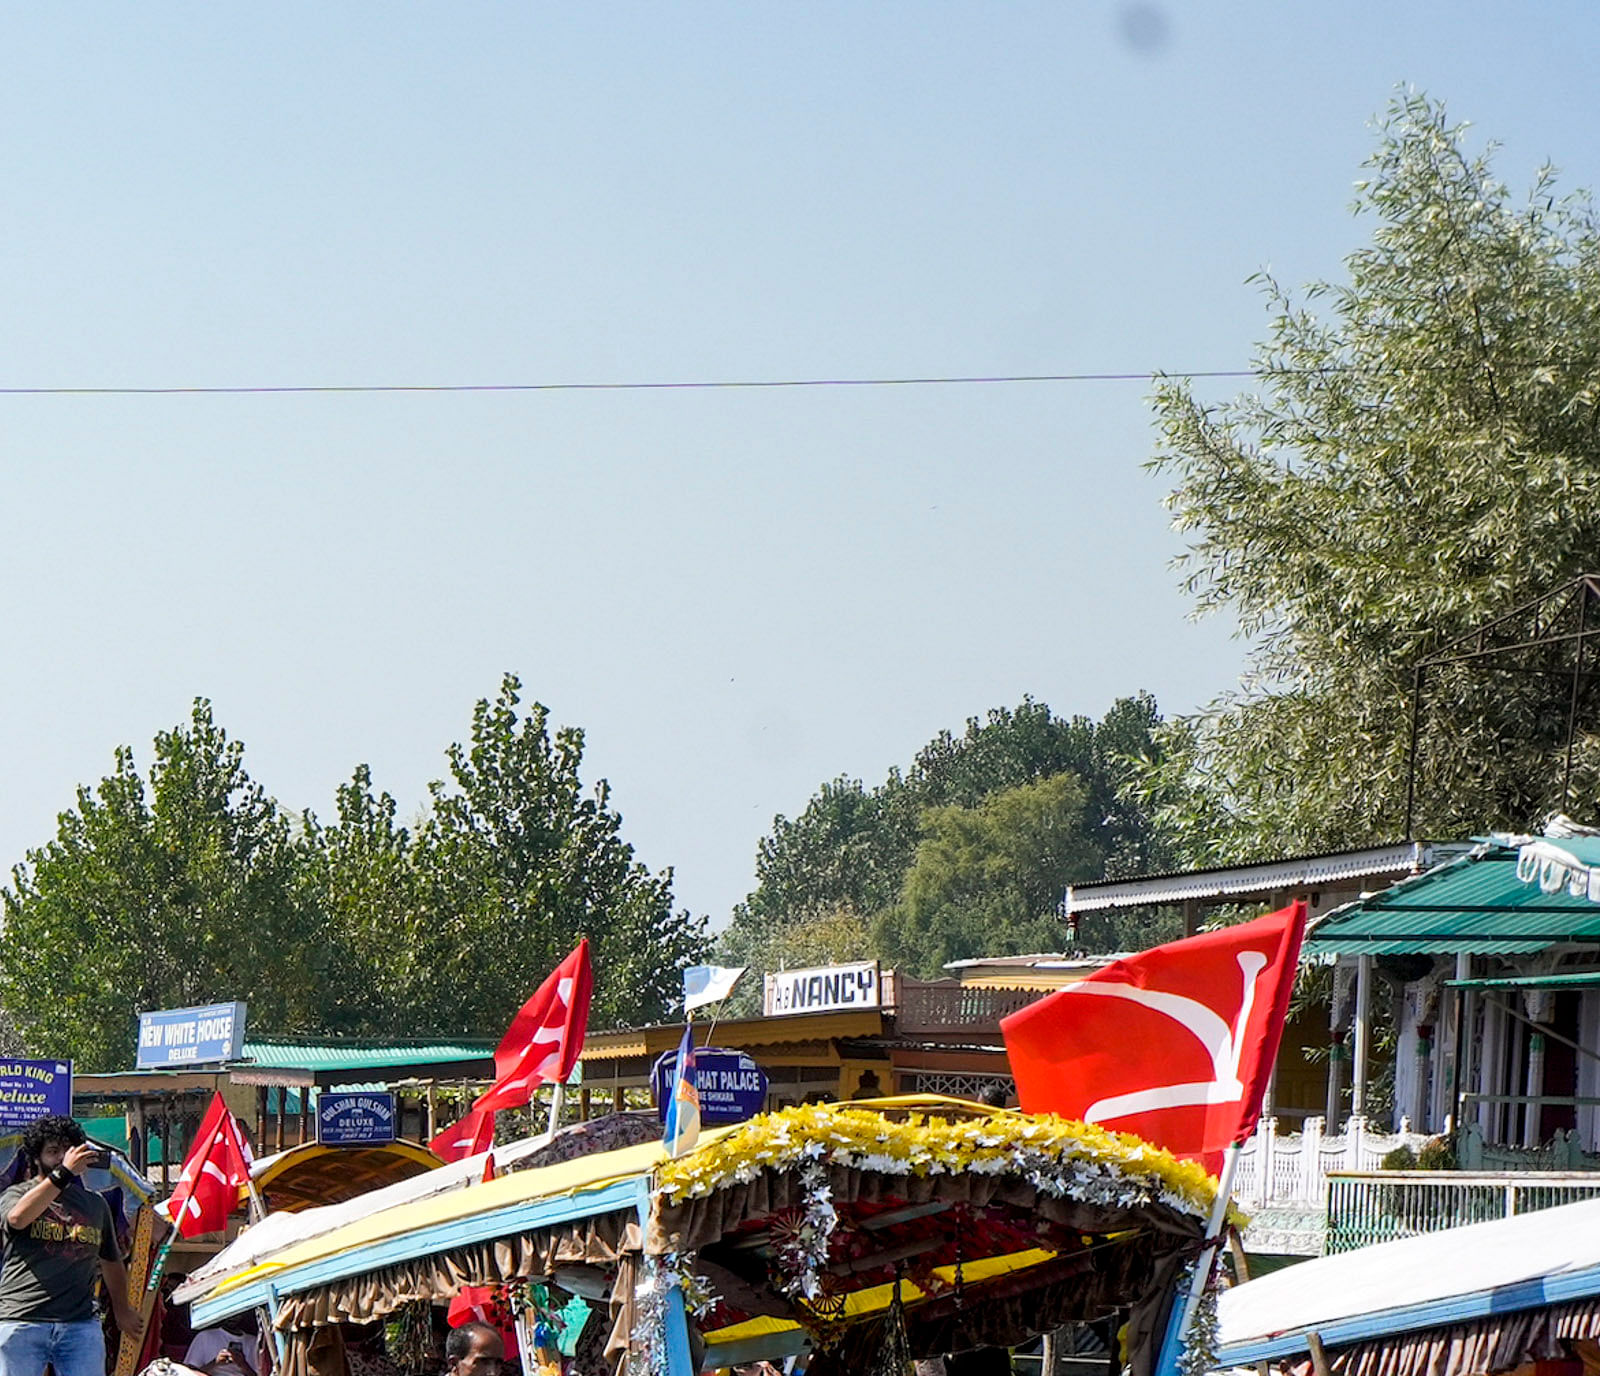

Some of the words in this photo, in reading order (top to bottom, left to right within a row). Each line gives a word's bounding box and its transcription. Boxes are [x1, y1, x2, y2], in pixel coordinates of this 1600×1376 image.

[791, 970, 873, 1008] NANCY
[141, 1024, 163, 1048] NEW
[164, 1021, 196, 1047] WHITE
[196, 1016, 232, 1043] HOUSE
[168, 1046, 198, 1060] DELUXE
[24, 1065, 54, 1084] KING
[720, 1071, 760, 1091] PALACE
[707, 1092, 735, 1102] SHIKARA
[321, 1098, 356, 1121] GULSHAN
[357, 1097, 392, 1121] GULSHAN
[338, 1118, 374, 1127] DELUXE
[30, 1221, 64, 1241] NEW
